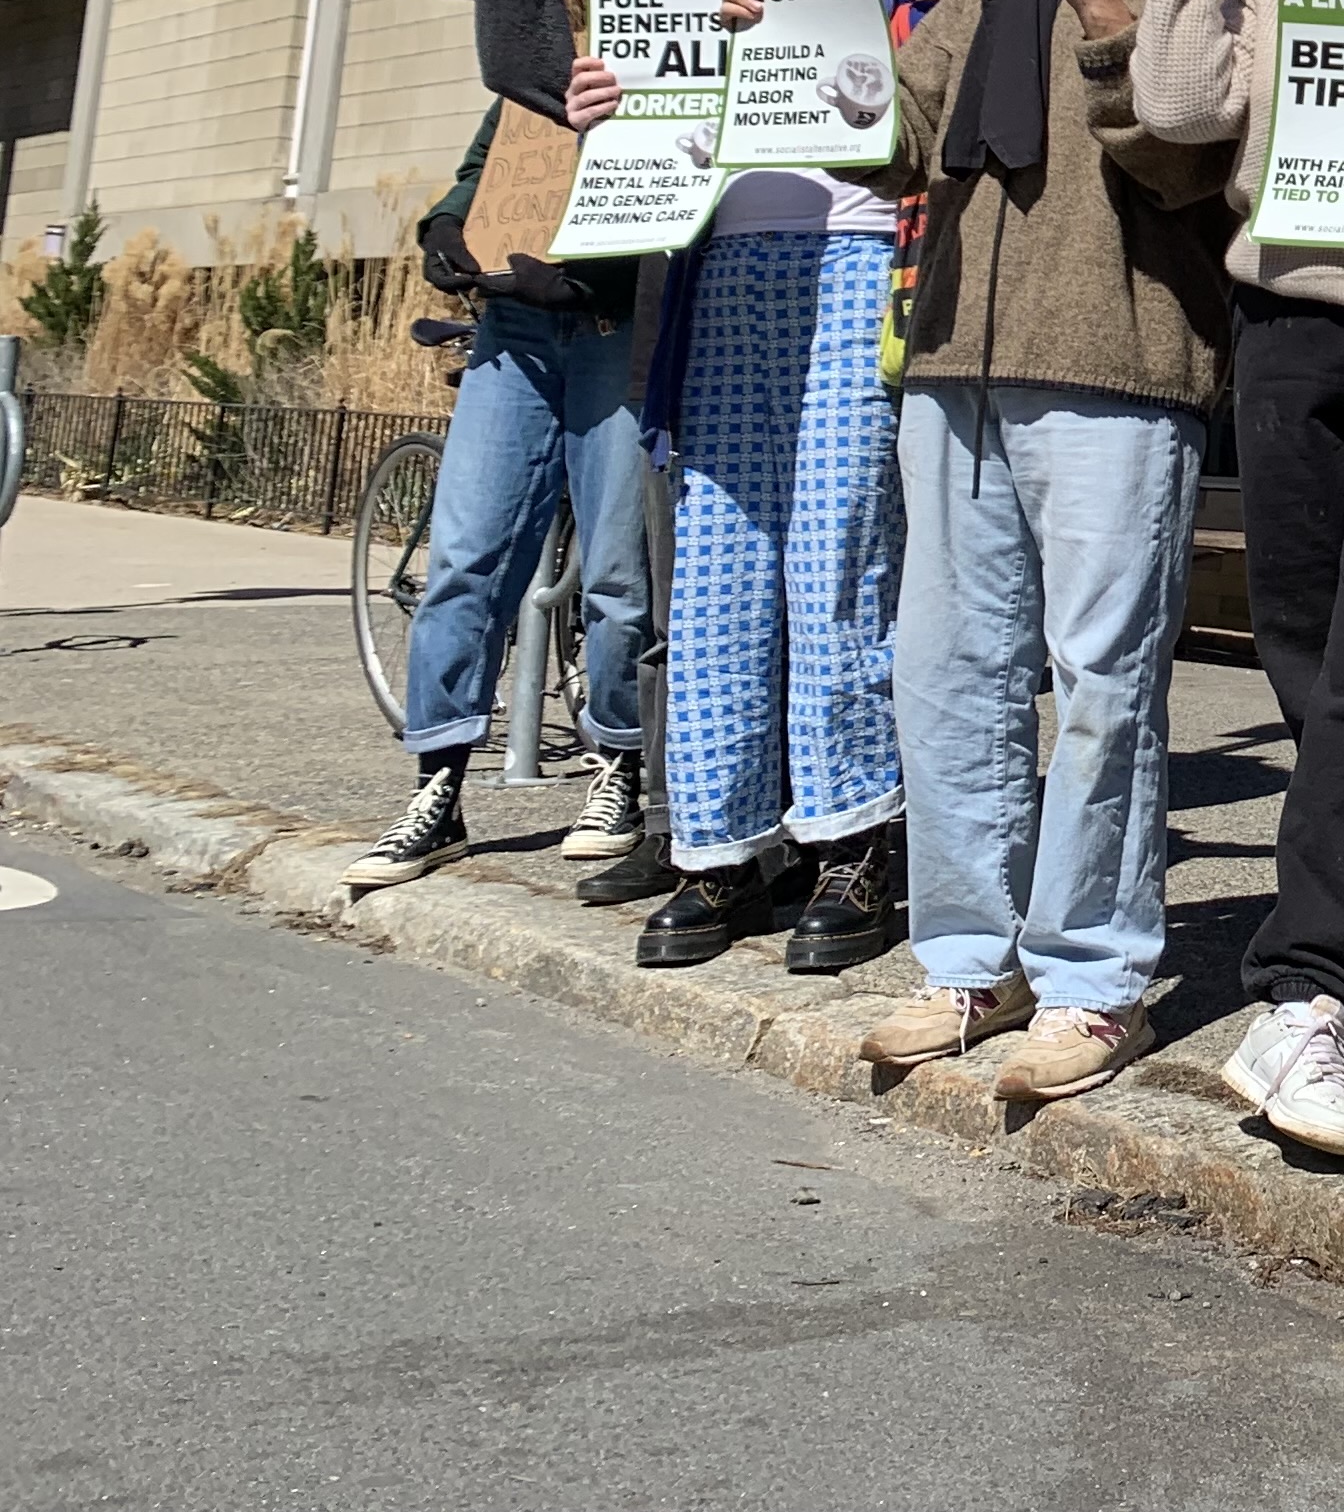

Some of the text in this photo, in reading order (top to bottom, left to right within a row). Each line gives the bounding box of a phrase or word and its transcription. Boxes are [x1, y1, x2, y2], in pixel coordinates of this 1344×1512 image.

[598, 12, 723, 34] BENEFITS
[598, 39, 650, 59] FOR
[742, 44, 825, 61] REBUILD A
[739, 67, 817, 83] FIGHTING
[737, 90, 793, 105] LABOR
[734, 110, 830, 126] MOVEMENT
[754, 143, 862, 155] www.socialistalternative.org
[585, 158, 679, 172] INCLUDING:
[1277, 157, 1323, 172] WITH
[580, 174, 711, 189] MENTAL HEALTH
[1274, 173, 1310, 187] PAY
[574, 193, 679, 208] AND GENDER-
[1272, 187, 1311, 201] TIED
[1316, 190, 1339, 203] TO
[497, 189, 567, 224] CONT
[568, 209, 698, 226] AFFIRMING CARE
